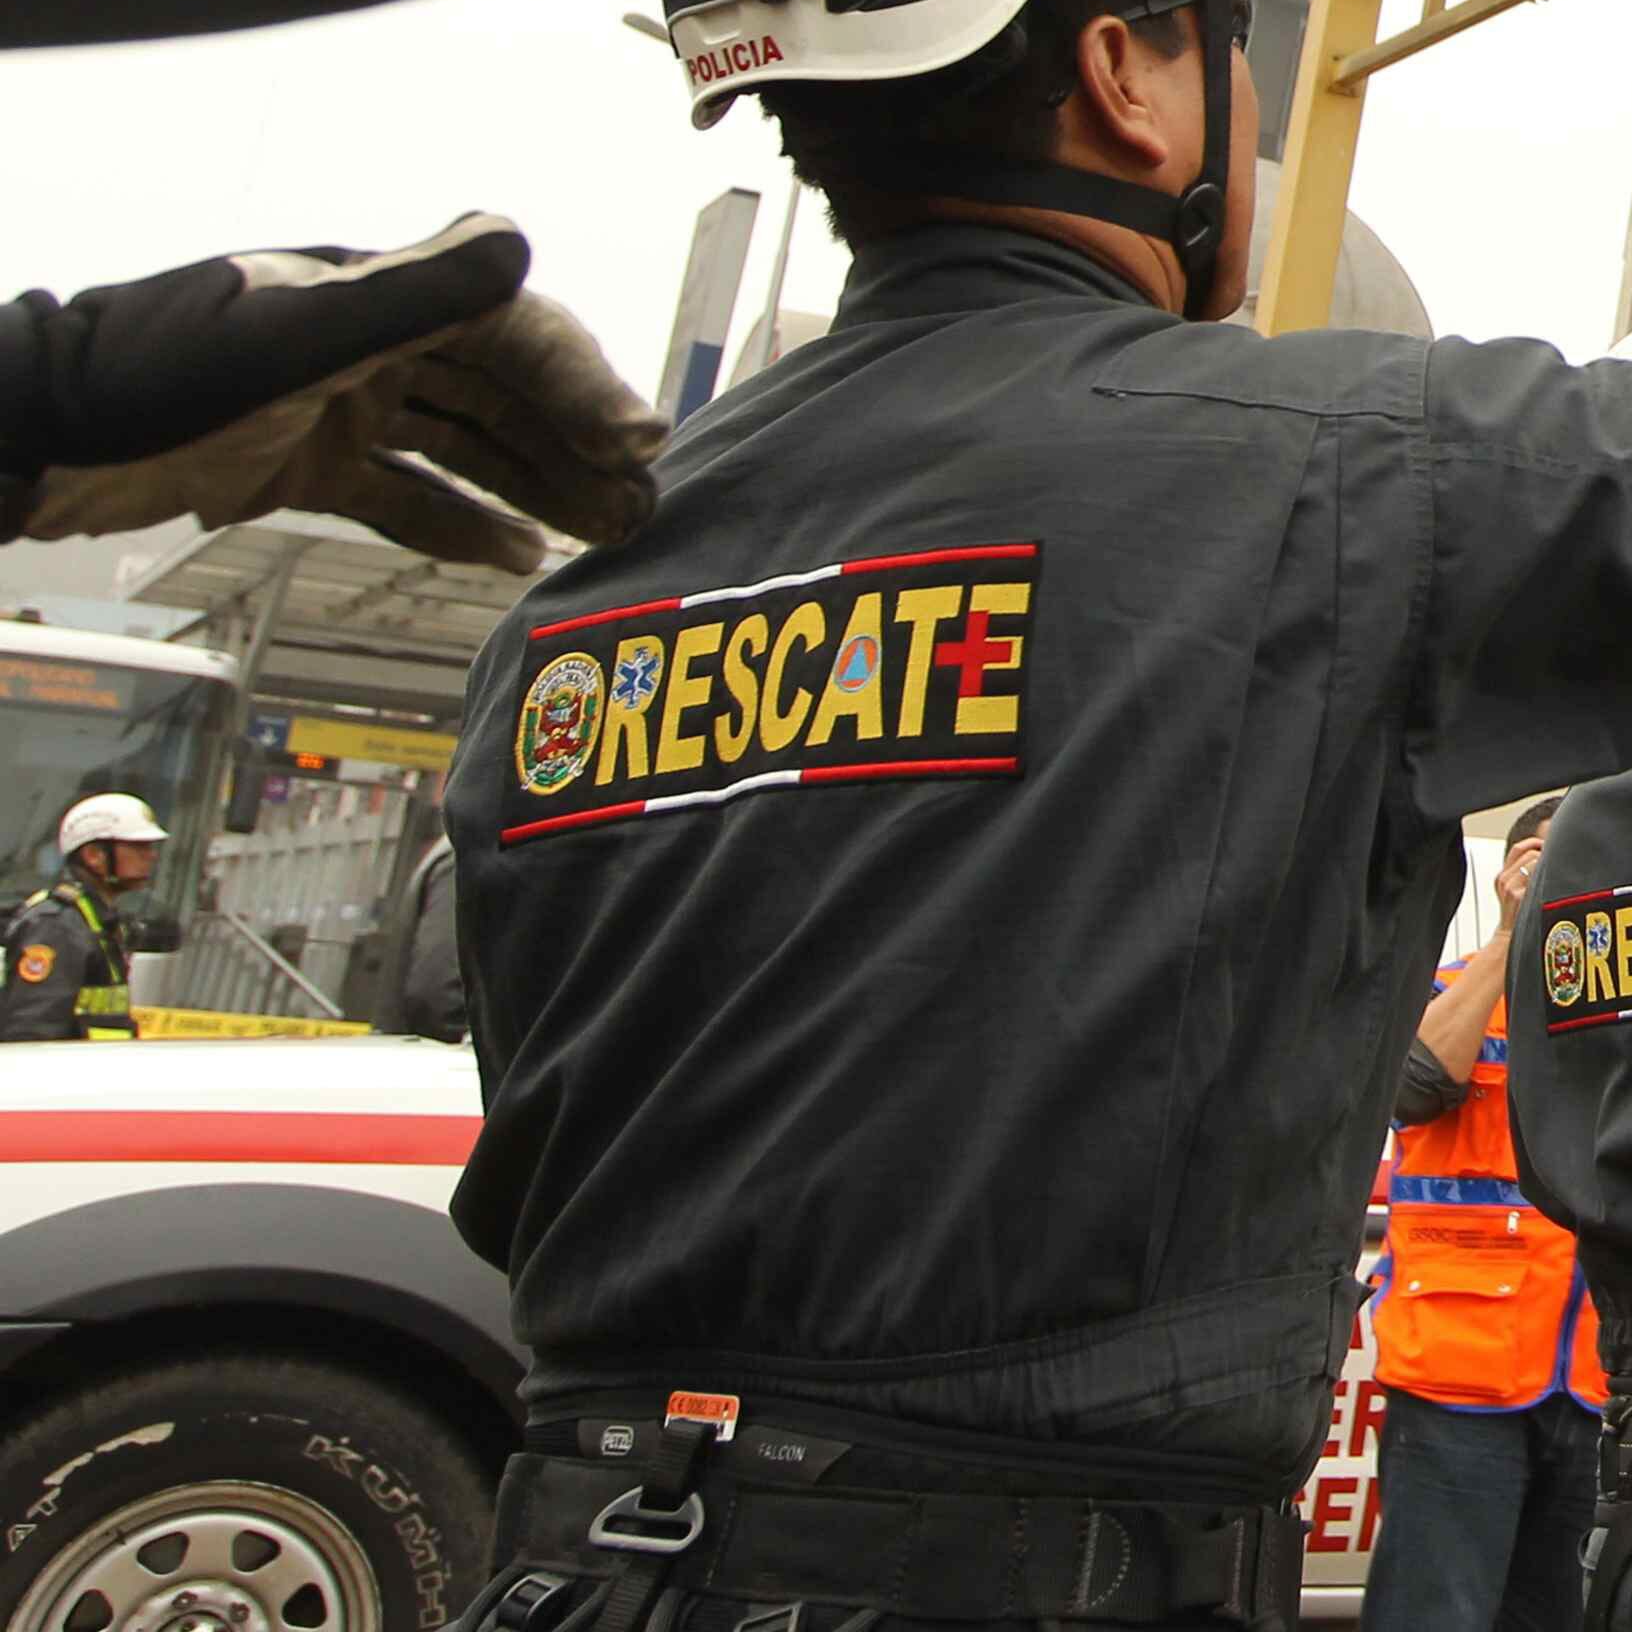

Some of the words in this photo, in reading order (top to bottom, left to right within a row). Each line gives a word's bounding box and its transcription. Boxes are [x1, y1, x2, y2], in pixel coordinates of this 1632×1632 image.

[686, 34, 784, 86] POLICIA
[594, 581, 1032, 786] RESCATE
[759, 1442, 806, 1461] FALCON
